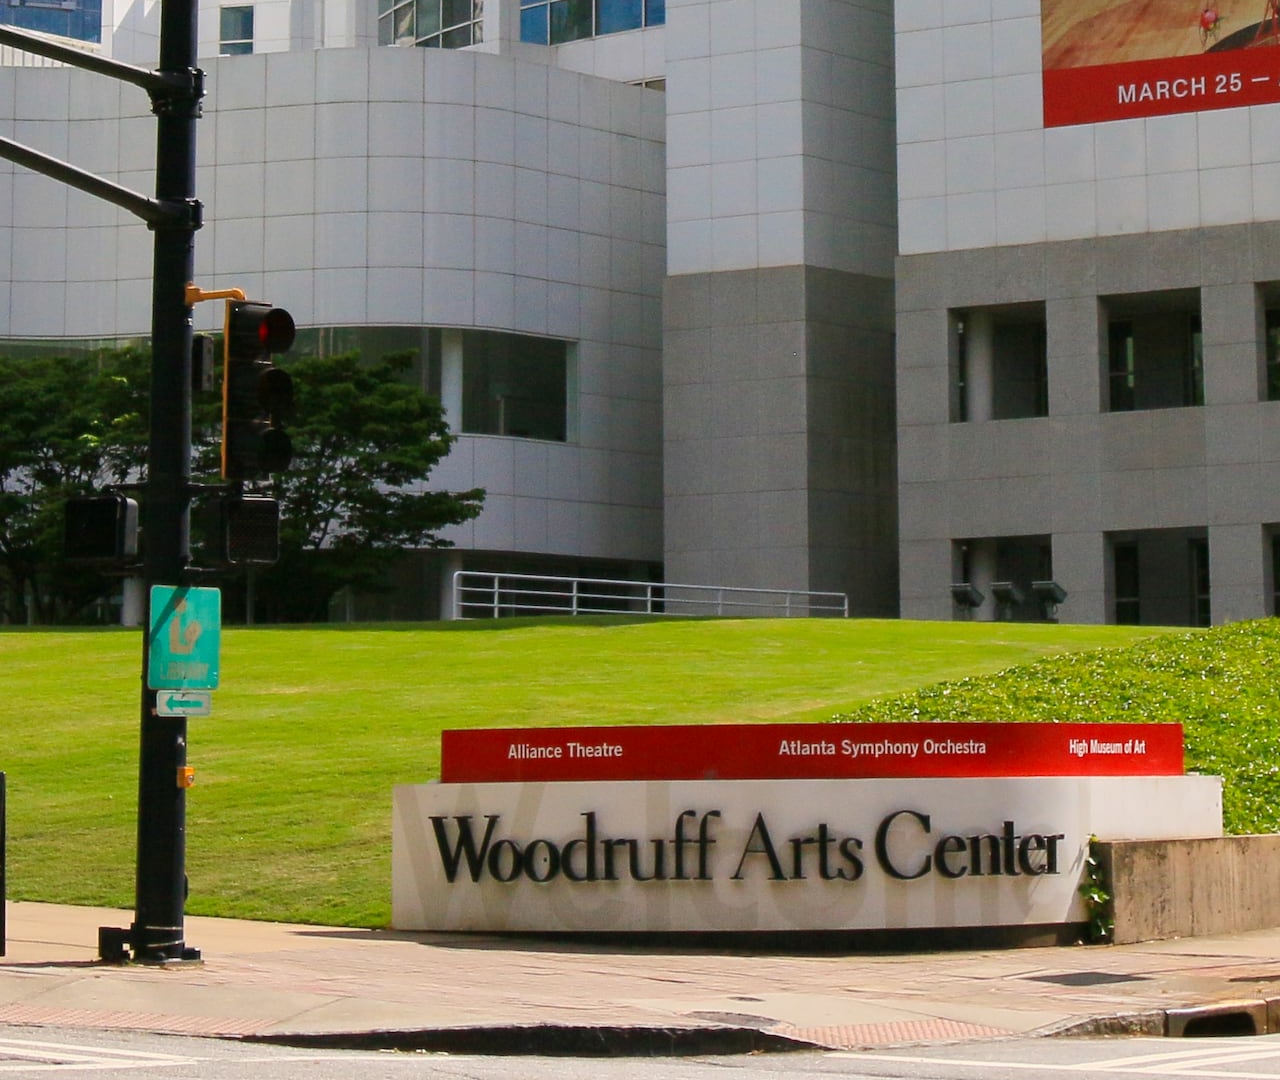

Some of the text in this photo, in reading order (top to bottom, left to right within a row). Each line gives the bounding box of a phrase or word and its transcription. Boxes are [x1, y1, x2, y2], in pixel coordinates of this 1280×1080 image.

[1117, 76, 1205, 104] MARCH
[1215, 73, 1242, 94] 25
[508, 742, 623, 759] Alliance Theatre
[778, 739, 986, 758] Atlanta Symphony Orchestra
[1069, 739, 1146, 757] High Museum of Art
[428, 809, 1064, 883] Woodruff Arts Center
